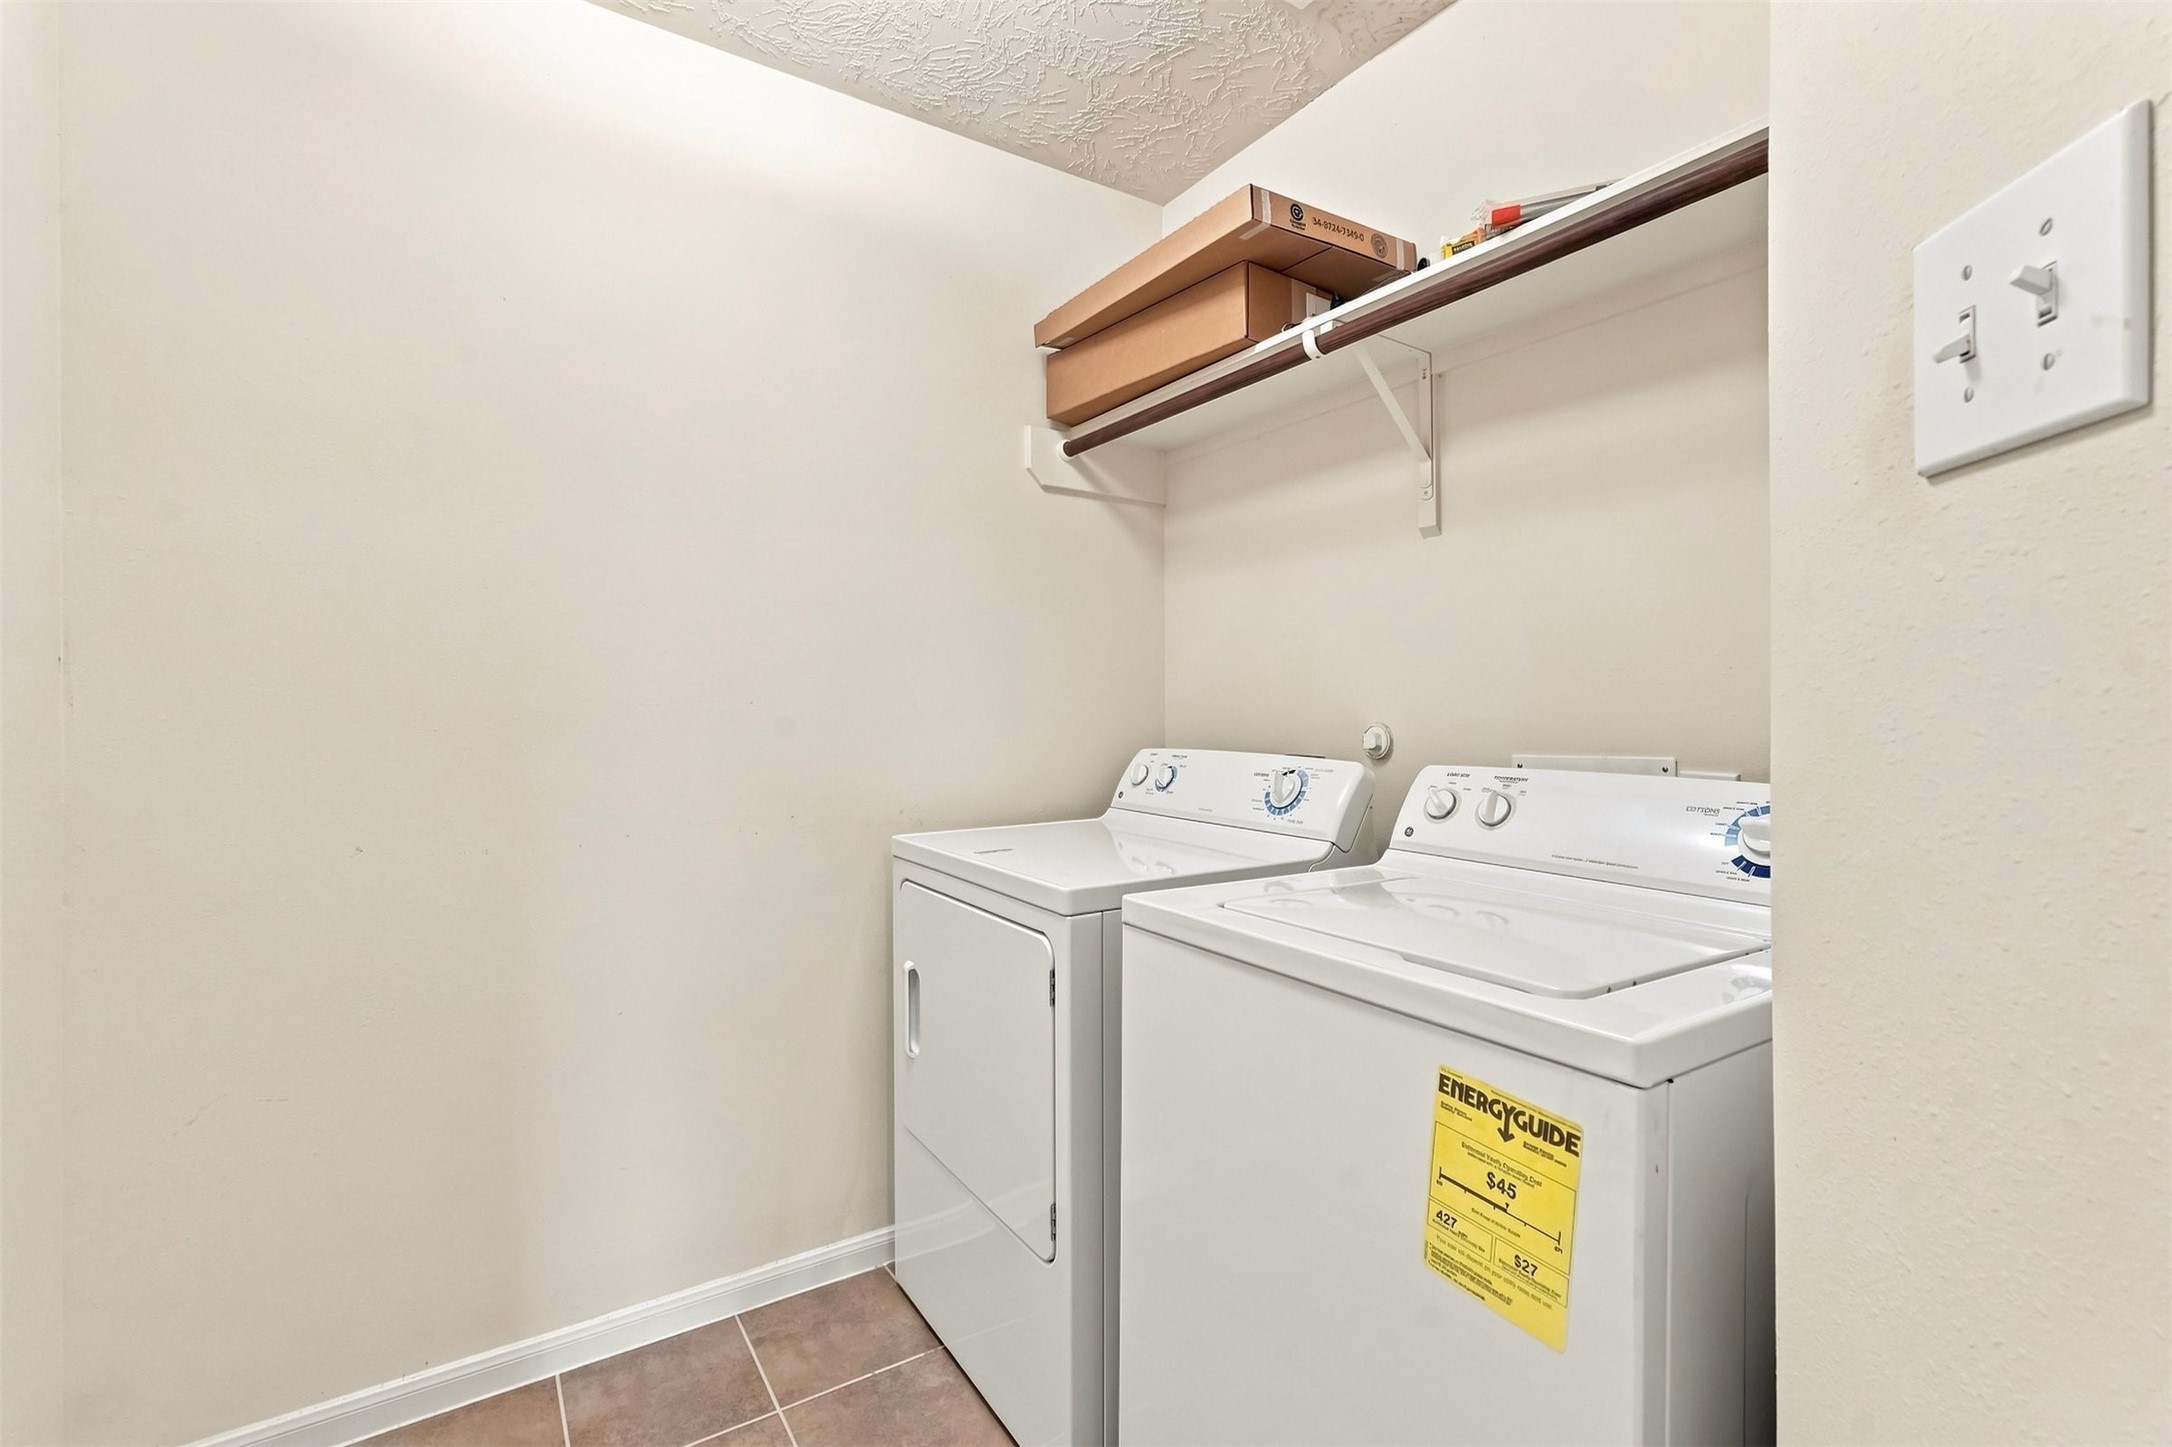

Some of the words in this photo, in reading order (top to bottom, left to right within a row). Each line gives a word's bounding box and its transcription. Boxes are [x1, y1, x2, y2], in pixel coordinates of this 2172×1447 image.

[1438, 1073, 1581, 1158] ENERGYGUIDE
[1486, 1171, 1517, 1200] $45
[1435, 1210, 1458, 1228] 427
[1514, 1254, 1538, 1277] $27
